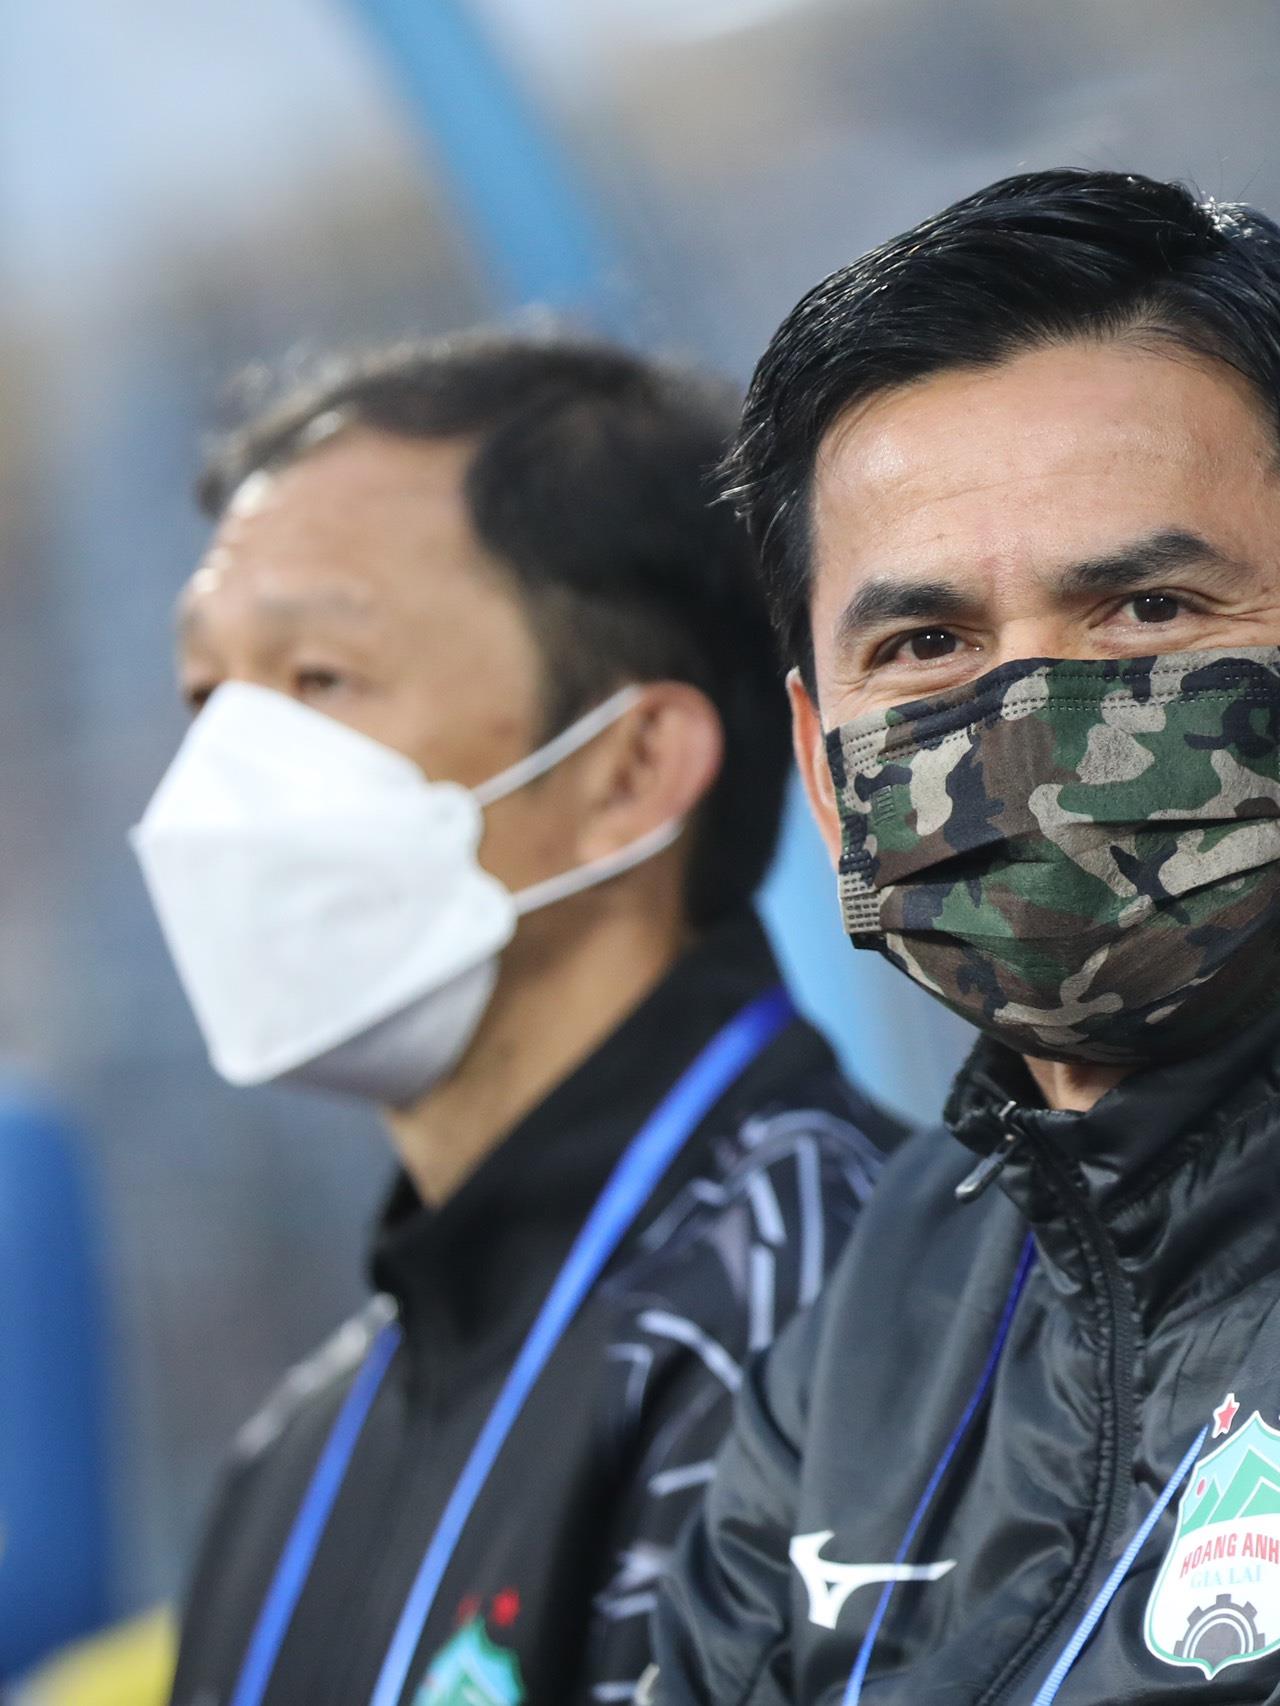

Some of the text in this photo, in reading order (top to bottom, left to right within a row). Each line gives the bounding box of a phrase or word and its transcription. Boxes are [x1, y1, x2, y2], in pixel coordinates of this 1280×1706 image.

[1180, 1533, 1280, 1578] HOANG ANH
[1227, 1565, 1261, 1584] LAI
